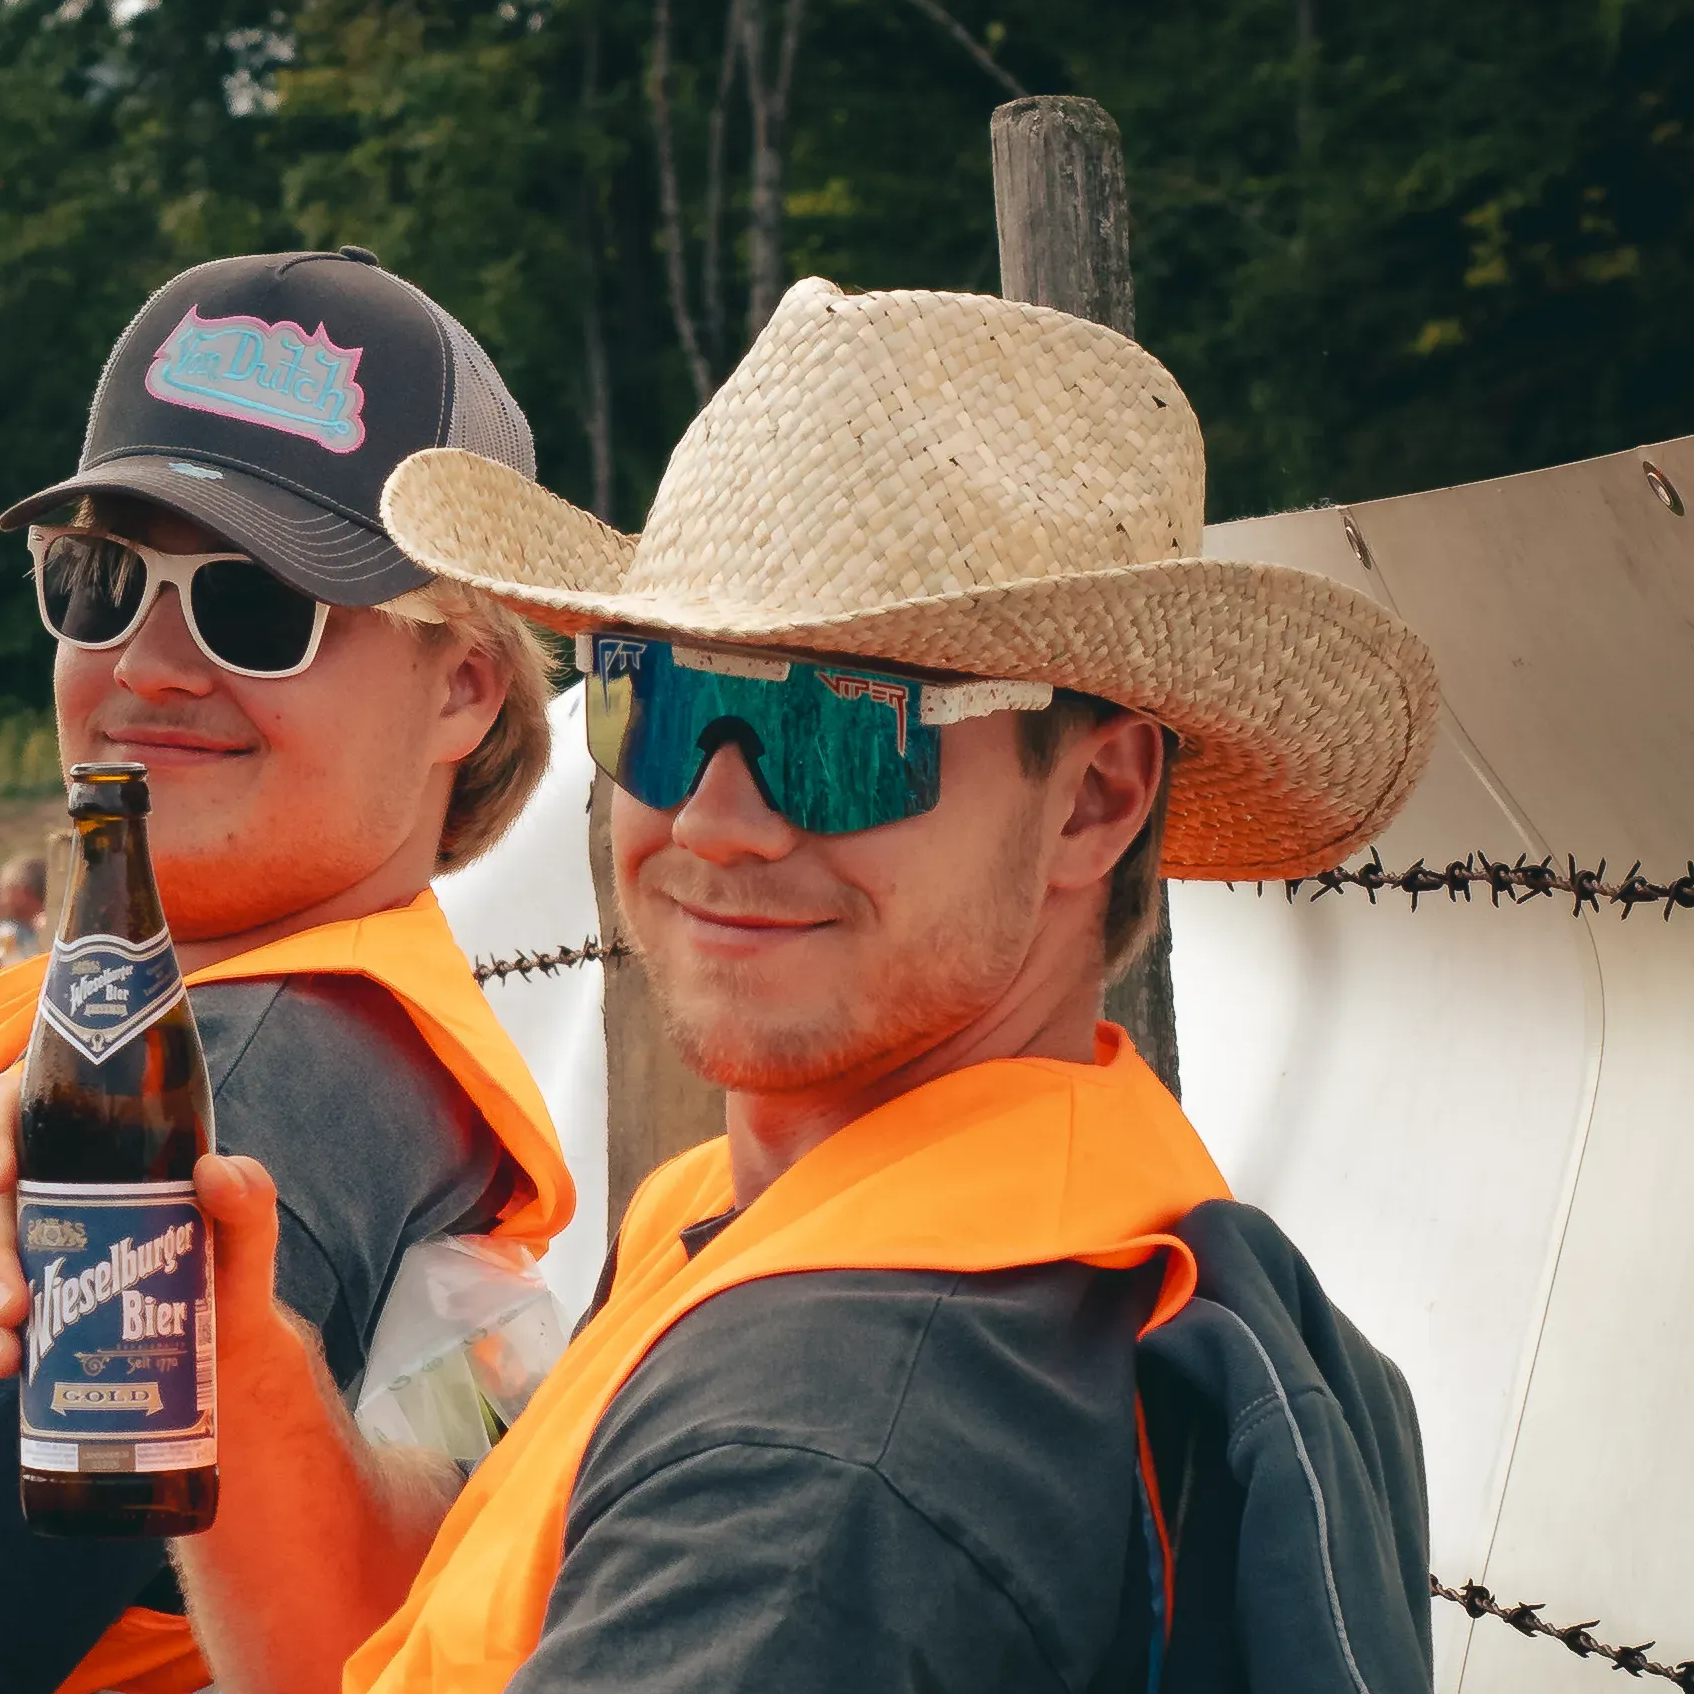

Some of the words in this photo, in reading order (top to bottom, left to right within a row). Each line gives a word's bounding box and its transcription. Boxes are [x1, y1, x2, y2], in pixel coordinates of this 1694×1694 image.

[198, 328, 347, 422] Dutch
[814, 670, 909, 758] VIPER
[27, 1220, 195, 1387] Wieselburger
[121, 1289, 188, 1342] Bier
[62, 1389, 150, 1403] GOLD
